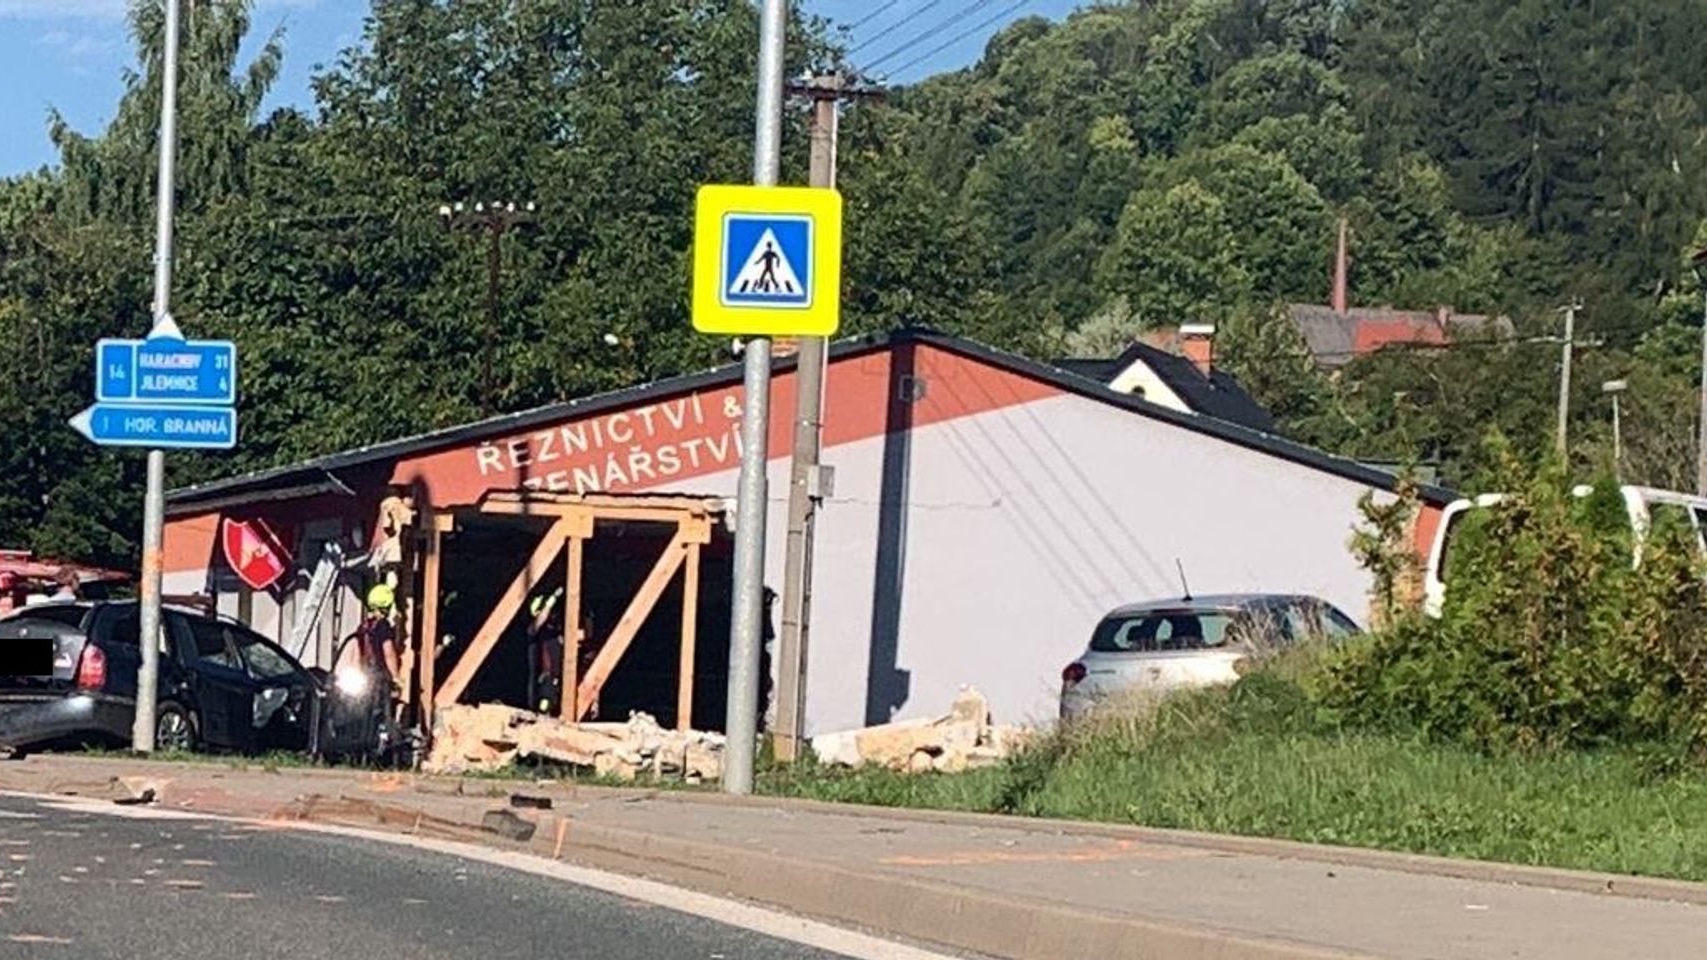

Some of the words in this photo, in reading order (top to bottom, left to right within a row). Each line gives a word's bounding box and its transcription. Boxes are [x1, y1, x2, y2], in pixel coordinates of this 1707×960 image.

[214, 354, 228, 370] 31
[163, 416, 228, 435] BRANNÁ
[475, 391, 704, 475] ŘEZNICTVÍ
[723, 395, 743, 418] &
